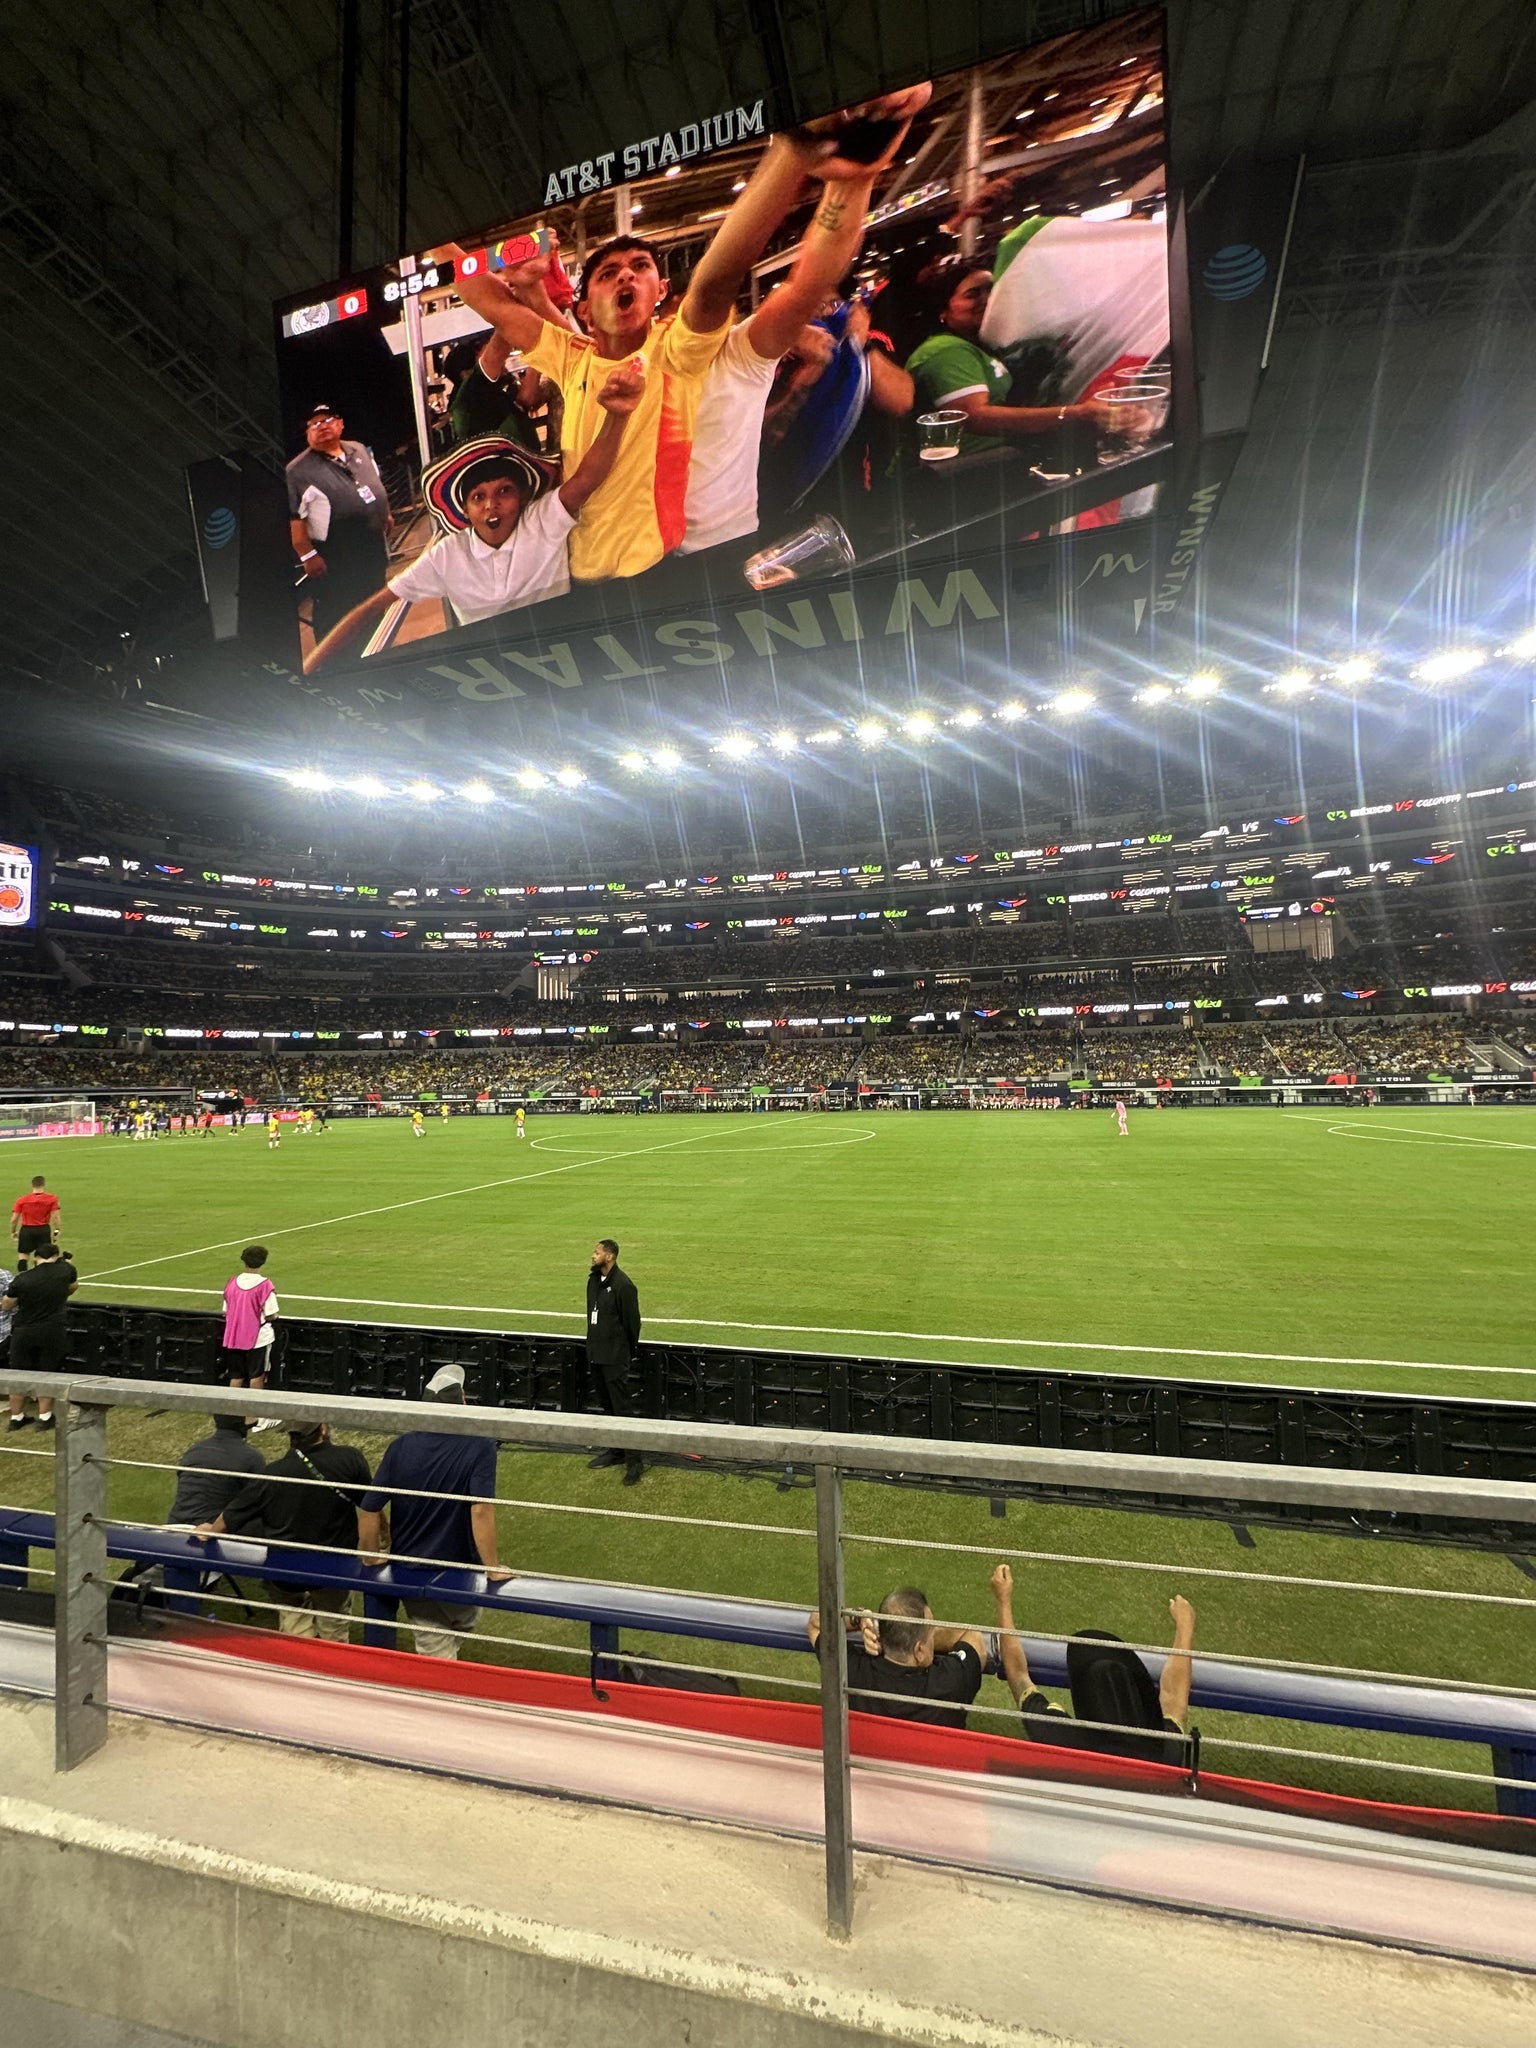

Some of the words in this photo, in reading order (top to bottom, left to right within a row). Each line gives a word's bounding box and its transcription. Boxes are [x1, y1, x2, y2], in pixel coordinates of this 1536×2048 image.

[543, 151, 616, 206] AT&T
[623, 100, 765, 178] STADIUM
[462, 255, 478, 275] 0
[383, 269, 440, 302] 8:54
[343, 296, 358, 314] 0
[1152, 482, 1222, 615] WINSTAR
[426, 568, 1000, 701] WINSTAR
[1395, 800, 1414, 811] VS
[1242, 821, 1259, 833] VS
[1045, 846, 1058, 856] VS
[122, 859, 141, 870] VS
[930, 858, 944, 868] VS
[1369, 861, 1391, 872] VS
[0, 862, 30, 880] ite
[776, 872, 788, 880] VS
[258, 878, 273, 887] VS
[675, 879, 687, 887] VS
[425, 888, 439, 896] VS
[525, 886, 537, 894] VS
[1110, 890, 1127, 899] VS
[967, 903, 983, 912] VS
[124, 911, 144, 920] VS
[779, 918, 793, 926] VS
[658, 924, 672, 932] VS
[351, 930, 367, 938] VS
[479, 931, 492, 939] VS
[1485, 983, 1507, 993] VS
[1303, 993, 1323, 1004] VS
[1075, 1005, 1091, 1014] VS
[945, 1011, 961, 1020] VS
[663, 1022, 676, 1031] VS
[774, 1018, 787, 1027] VS
[204, 1029, 222, 1038] VS
[393, 1030, 407, 1039] VS
[500, 1028, 513, 1036] VS
